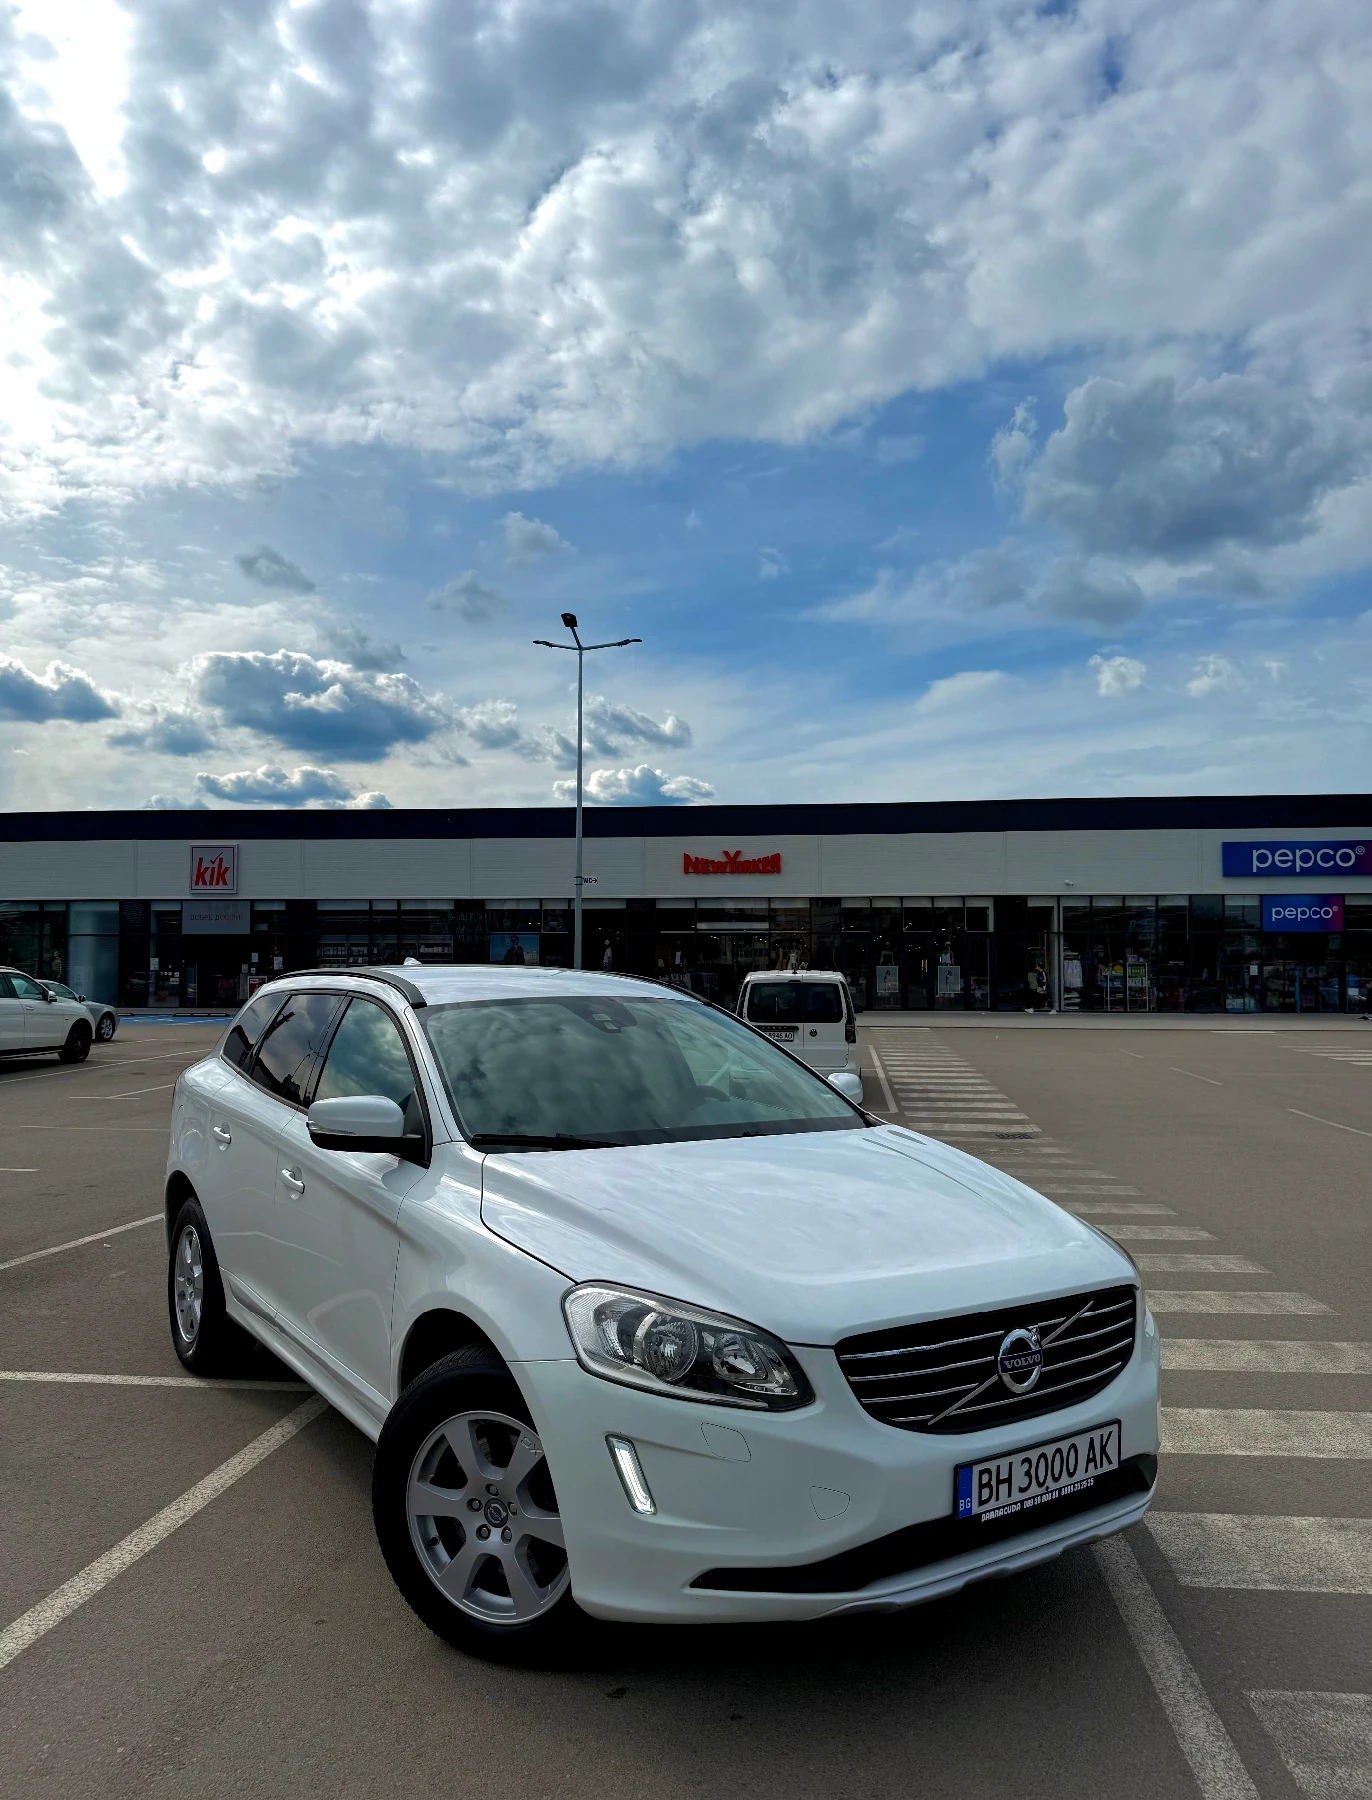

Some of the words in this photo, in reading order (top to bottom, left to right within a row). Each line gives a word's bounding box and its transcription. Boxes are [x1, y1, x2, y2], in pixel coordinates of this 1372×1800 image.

[1003, 1353, 1041, 1369] VOLVO
[959, 1497, 972, 1511] BG
[977, 1461, 1013, 1508] BH
[1018, 1442, 1079, 1493] 3000
[1084, 1430, 1114, 1474] AK
